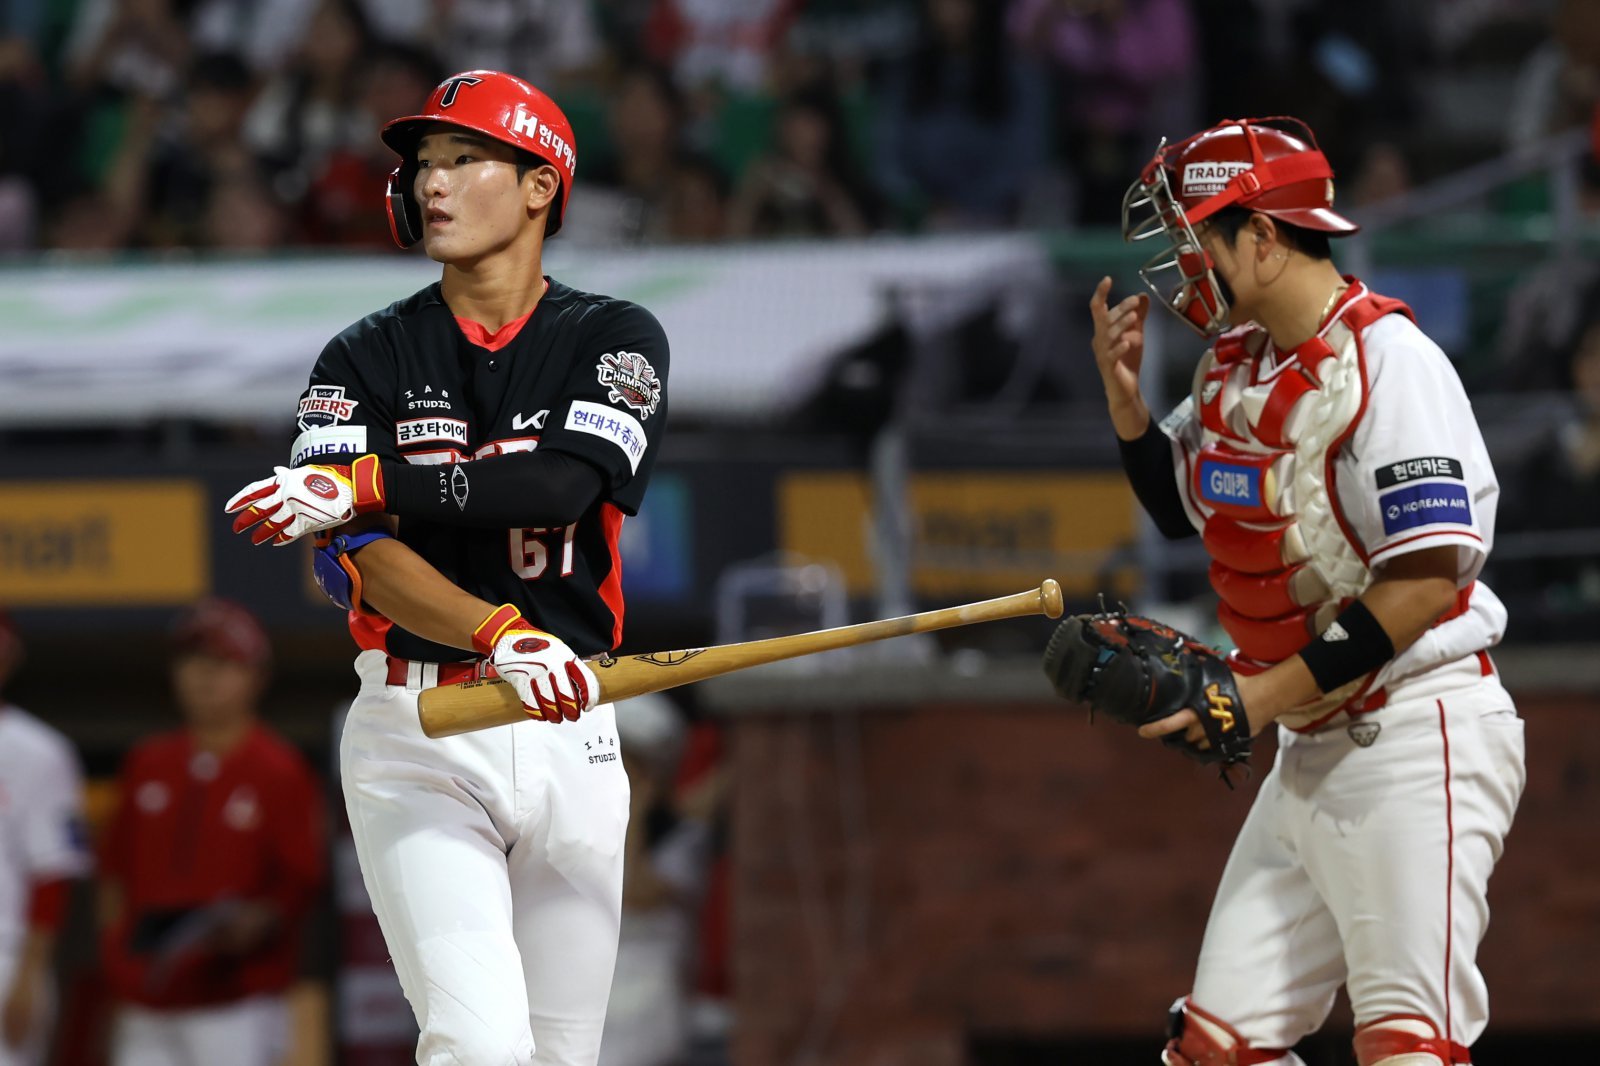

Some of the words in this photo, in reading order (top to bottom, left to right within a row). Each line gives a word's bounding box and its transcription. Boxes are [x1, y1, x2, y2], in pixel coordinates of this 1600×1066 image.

[1188, 167, 1246, 180] TRADE
[1187, 184, 1226, 192] WHOLESAL
[299, 399, 353, 418] TIGERS
[408, 400, 452, 410] STUDIO
[398, 420, 467, 441] 금호타이어
[573, 410, 642, 456] 현대차증권
[1391, 459, 1452, 481] 현대카드
[1210, 469, 1250, 498] G마켓
[1402, 498, 1448, 513] KOREAN
[1449, 498, 1467, 509] AIR
[588, 753, 617, 765] STUDIO
